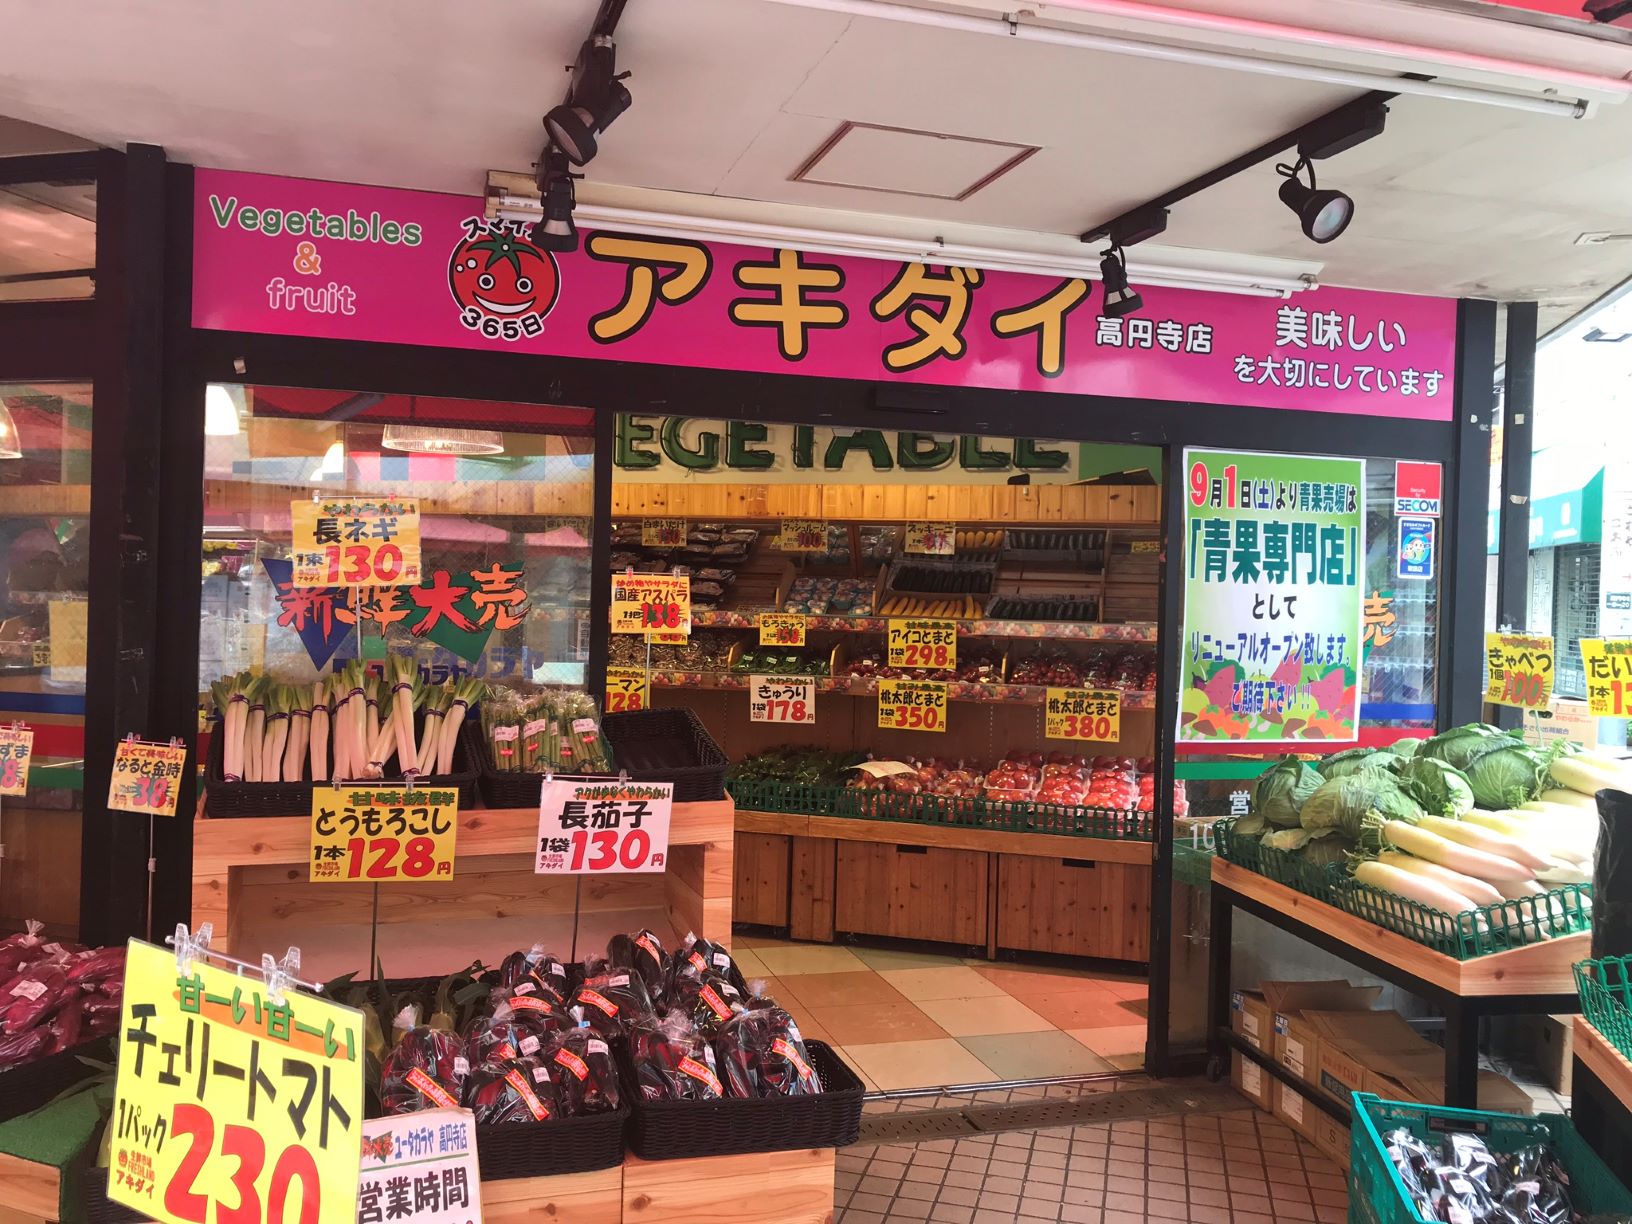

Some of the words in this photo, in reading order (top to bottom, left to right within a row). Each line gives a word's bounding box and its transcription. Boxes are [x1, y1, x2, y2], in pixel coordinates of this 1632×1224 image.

[209, 195, 422, 246] Vegetables
[293, 241, 321, 276] &
[266, 277, 356, 316] fruit
[585, 230, 1092, 378] アキダイ
[460, 305, 543, 341] 365日
[1095, 315, 1213, 355] 高円寺店
[1275, 305, 1407, 353] 美味しい
[1233, 353, 1445, 397] を大切にしています
[1397, 499, 1438, 512] SECOM
[312, 517, 399, 545] 長ネギ
[1189, 517, 1358, 587] 「青果専門店」
[615, 587, 688, 603] 国産アスパラ
[1252, 593, 1298, 620] として
[890, 629, 954, 646] アイコとまと
[1488, 646, 1553, 673] きゃべつ
[758, 685, 807, 700] きゅうり
[880, 689, 944, 707] 桃太郎とまと
[1048, 698, 1117, 717] 桃太郎とまと
[116, 757, 181, 779] なると金時
[348, 790, 456, 807] 甘味抜群
[315, 807, 452, 837] とうもろこし
[558, 801, 653, 830] 長茄子
[174, 973, 356, 1062] 甘ーい甘ーい
[126, 1003, 352, 1150] チェリートマト
[438, 1121, 468, 1153] 高円寺店
[164, 1103, 322, 1224] 230
[116, 1168, 155, 1200] アキダイ
[359, 1166, 470, 1224] 営業時間
